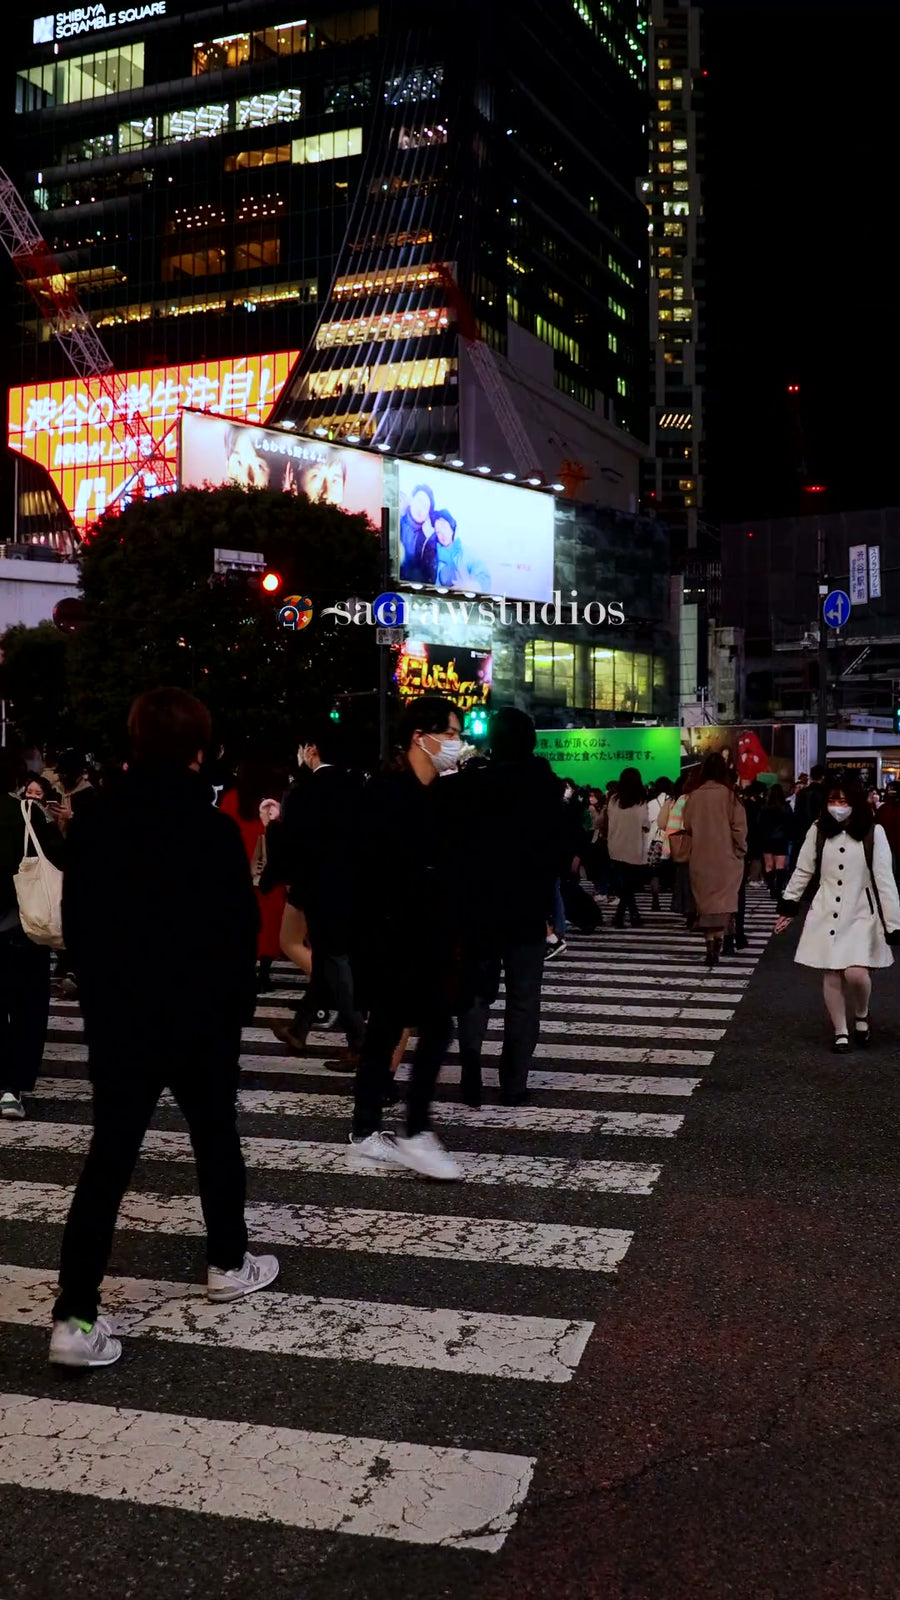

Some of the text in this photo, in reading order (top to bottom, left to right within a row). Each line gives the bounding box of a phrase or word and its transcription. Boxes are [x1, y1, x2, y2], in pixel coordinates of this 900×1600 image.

[55, 1, 166, 39] SCRAMBLE SQUARE
[56, 3, 106, 26] SHIBUYA
